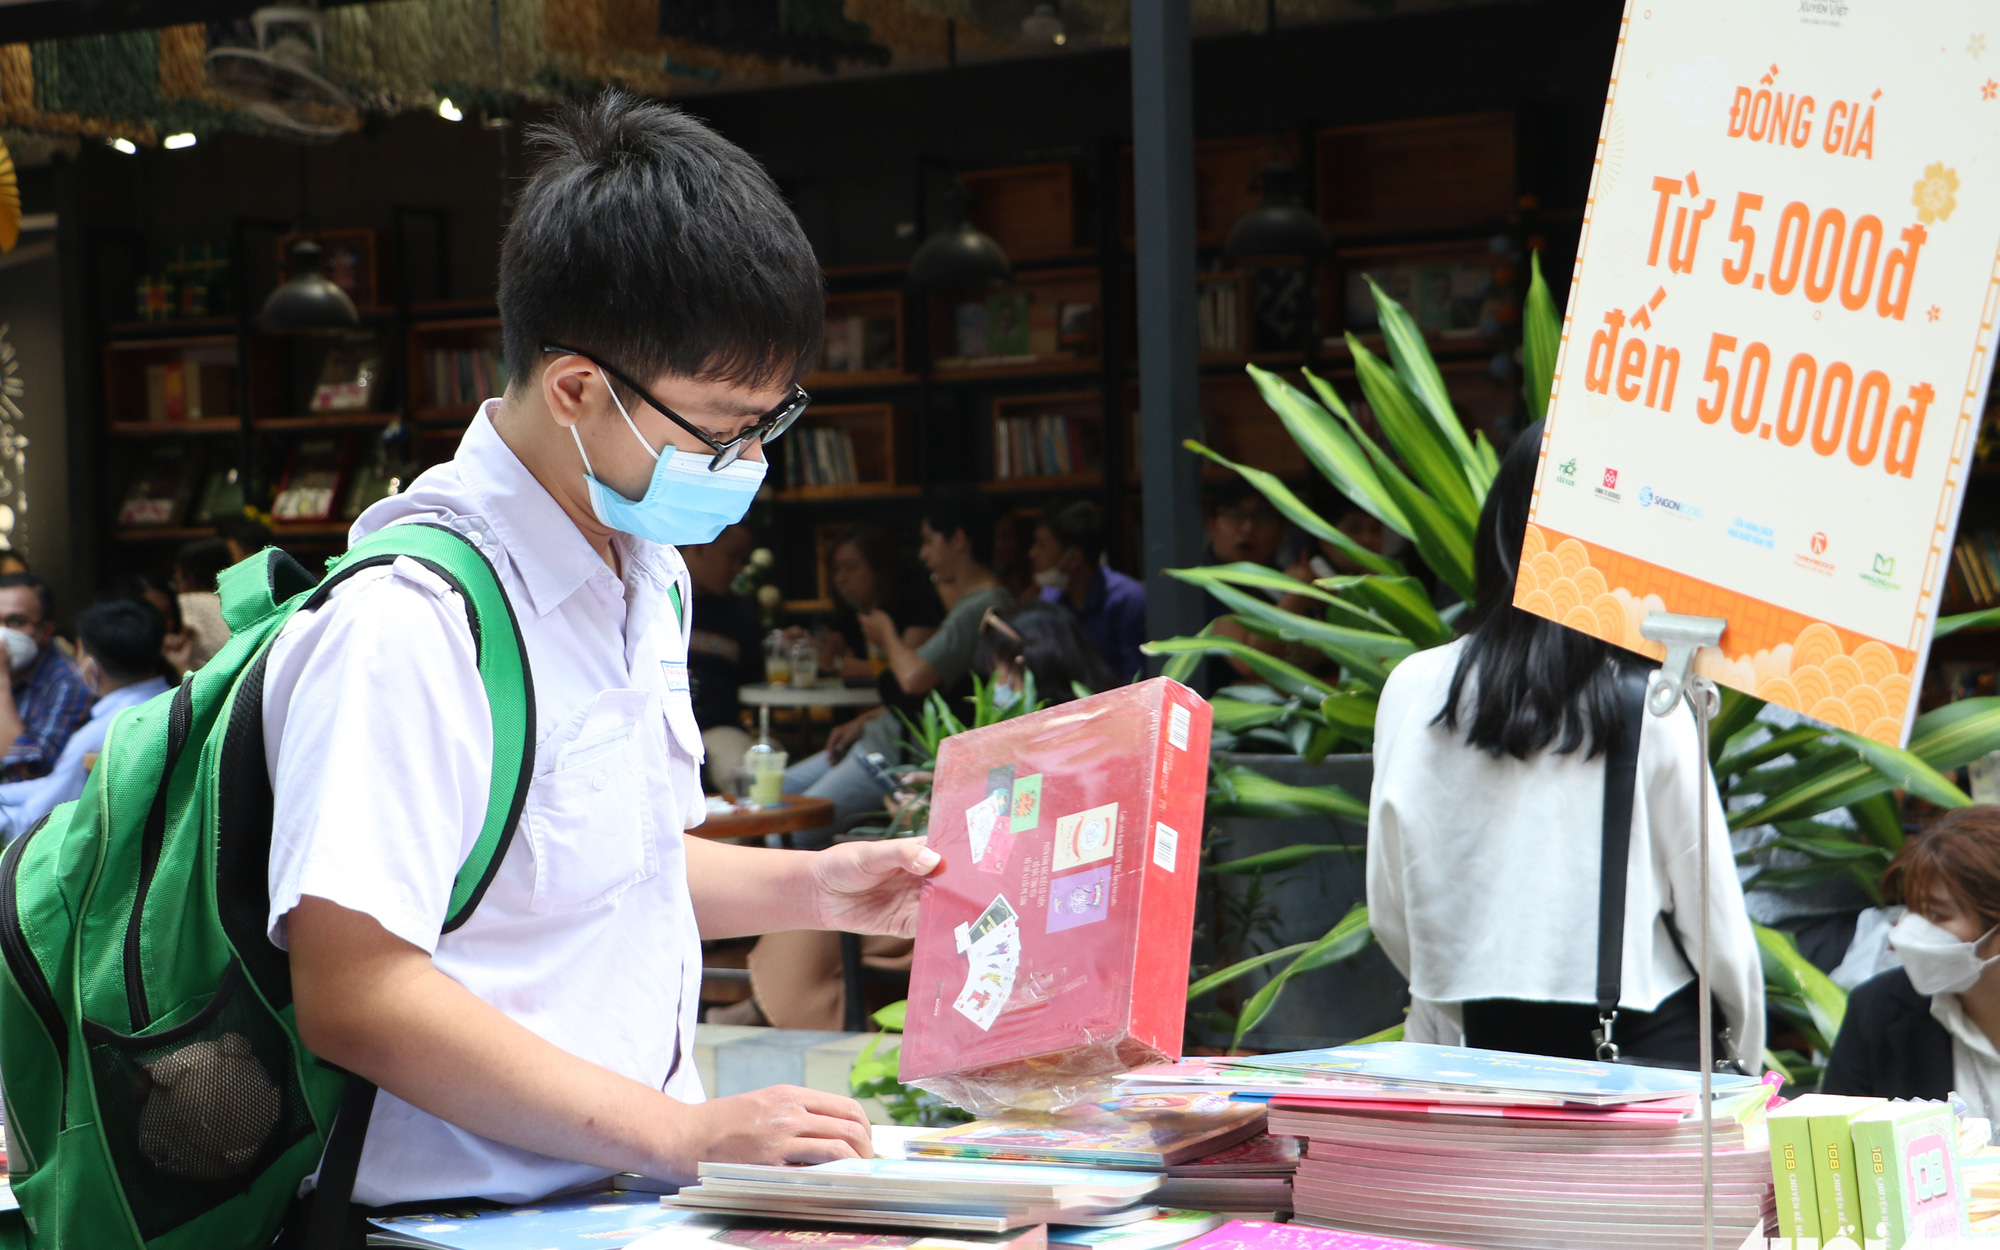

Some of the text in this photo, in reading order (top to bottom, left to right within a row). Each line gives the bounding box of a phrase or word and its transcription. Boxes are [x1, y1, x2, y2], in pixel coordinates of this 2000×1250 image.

[1727, 62, 1882, 160] ĐỒNG GIÁ
[1646, 170, 1928, 321] Từ 5.000đ
[1584, 285, 1935, 479] đến 50.000đ
[1783, 1144, 1796, 1170] 108
[1796, 1225, 1804, 1238] HA
[1827, 1143, 1840, 1170] 108
[1871, 1147, 1884, 1174] 108
[1909, 1148, 1948, 1204] 108
